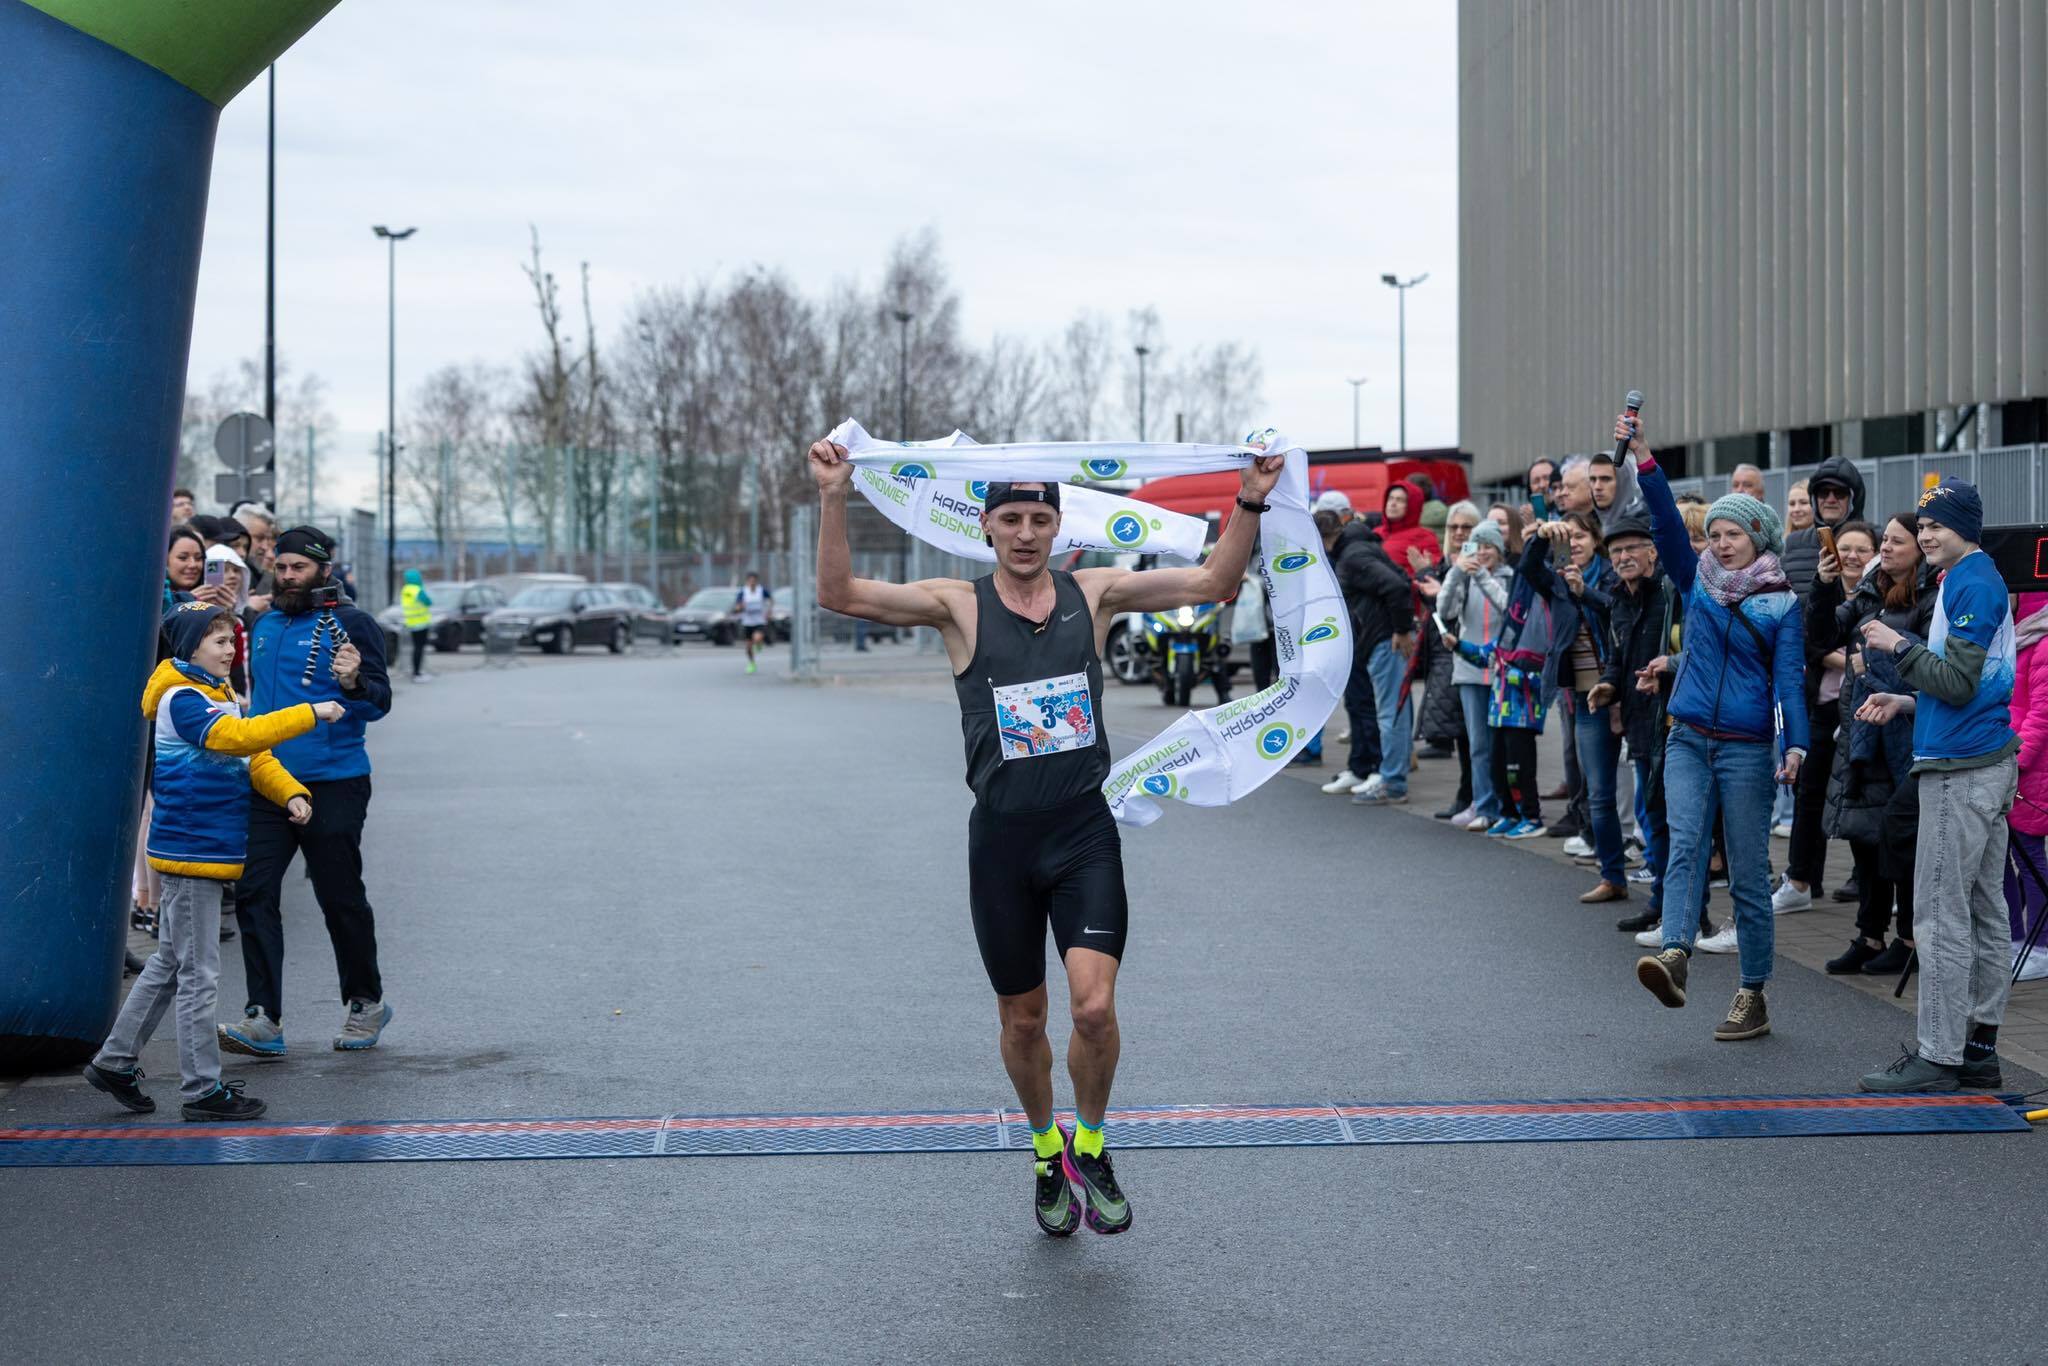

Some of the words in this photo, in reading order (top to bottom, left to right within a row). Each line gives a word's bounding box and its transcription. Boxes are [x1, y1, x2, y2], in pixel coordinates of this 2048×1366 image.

[932, 491, 981, 521] HARP
[930, 508, 987, 537] SOSNO
[1041, 704, 1056, 729] 3
